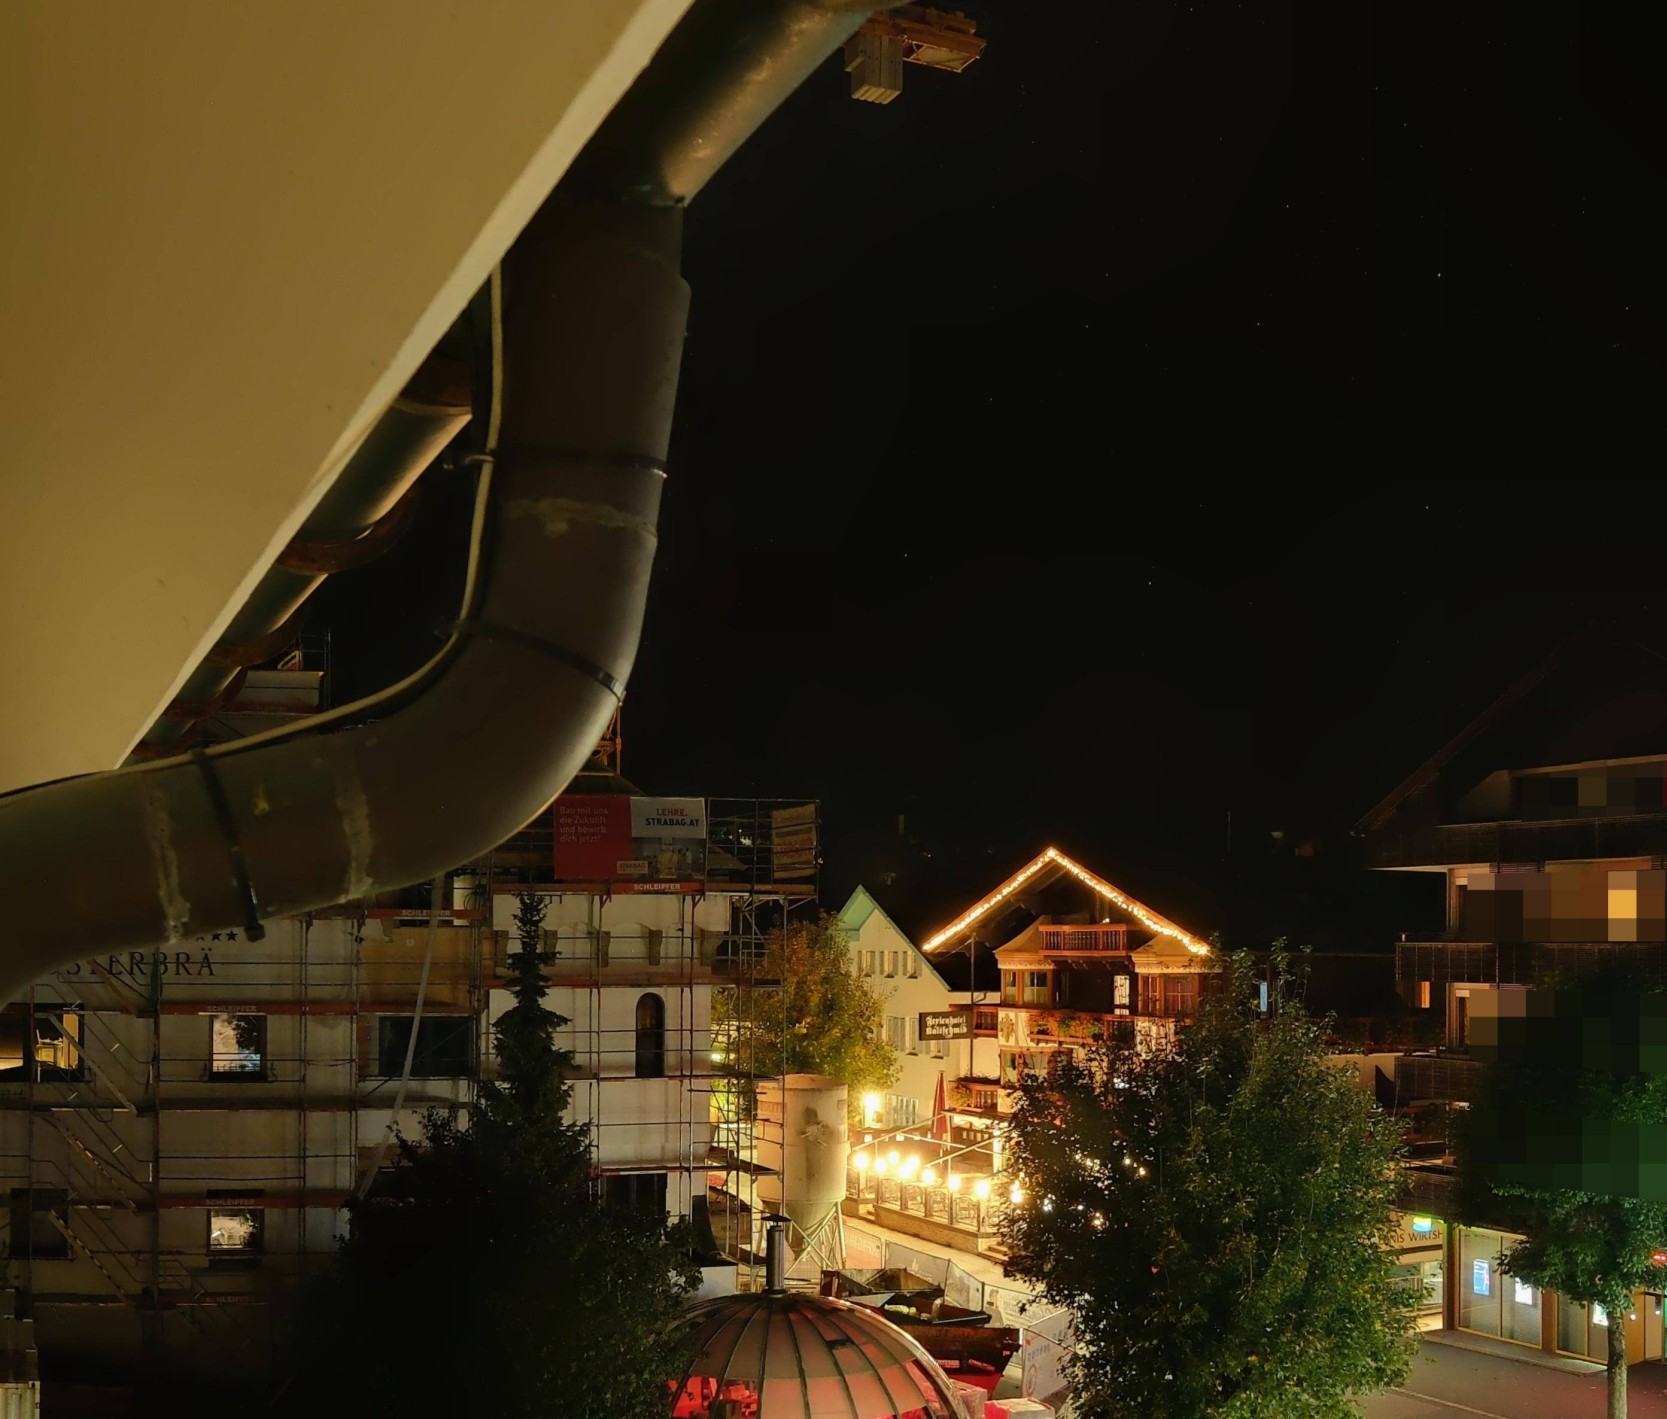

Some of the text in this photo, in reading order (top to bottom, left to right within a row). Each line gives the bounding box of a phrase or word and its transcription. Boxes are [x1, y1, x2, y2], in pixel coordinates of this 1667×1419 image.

[656, 808, 688, 817] LEHRE.
[574, 816, 607, 824] Zukunft
[645, 818, 700, 827] STRABAG.AT
